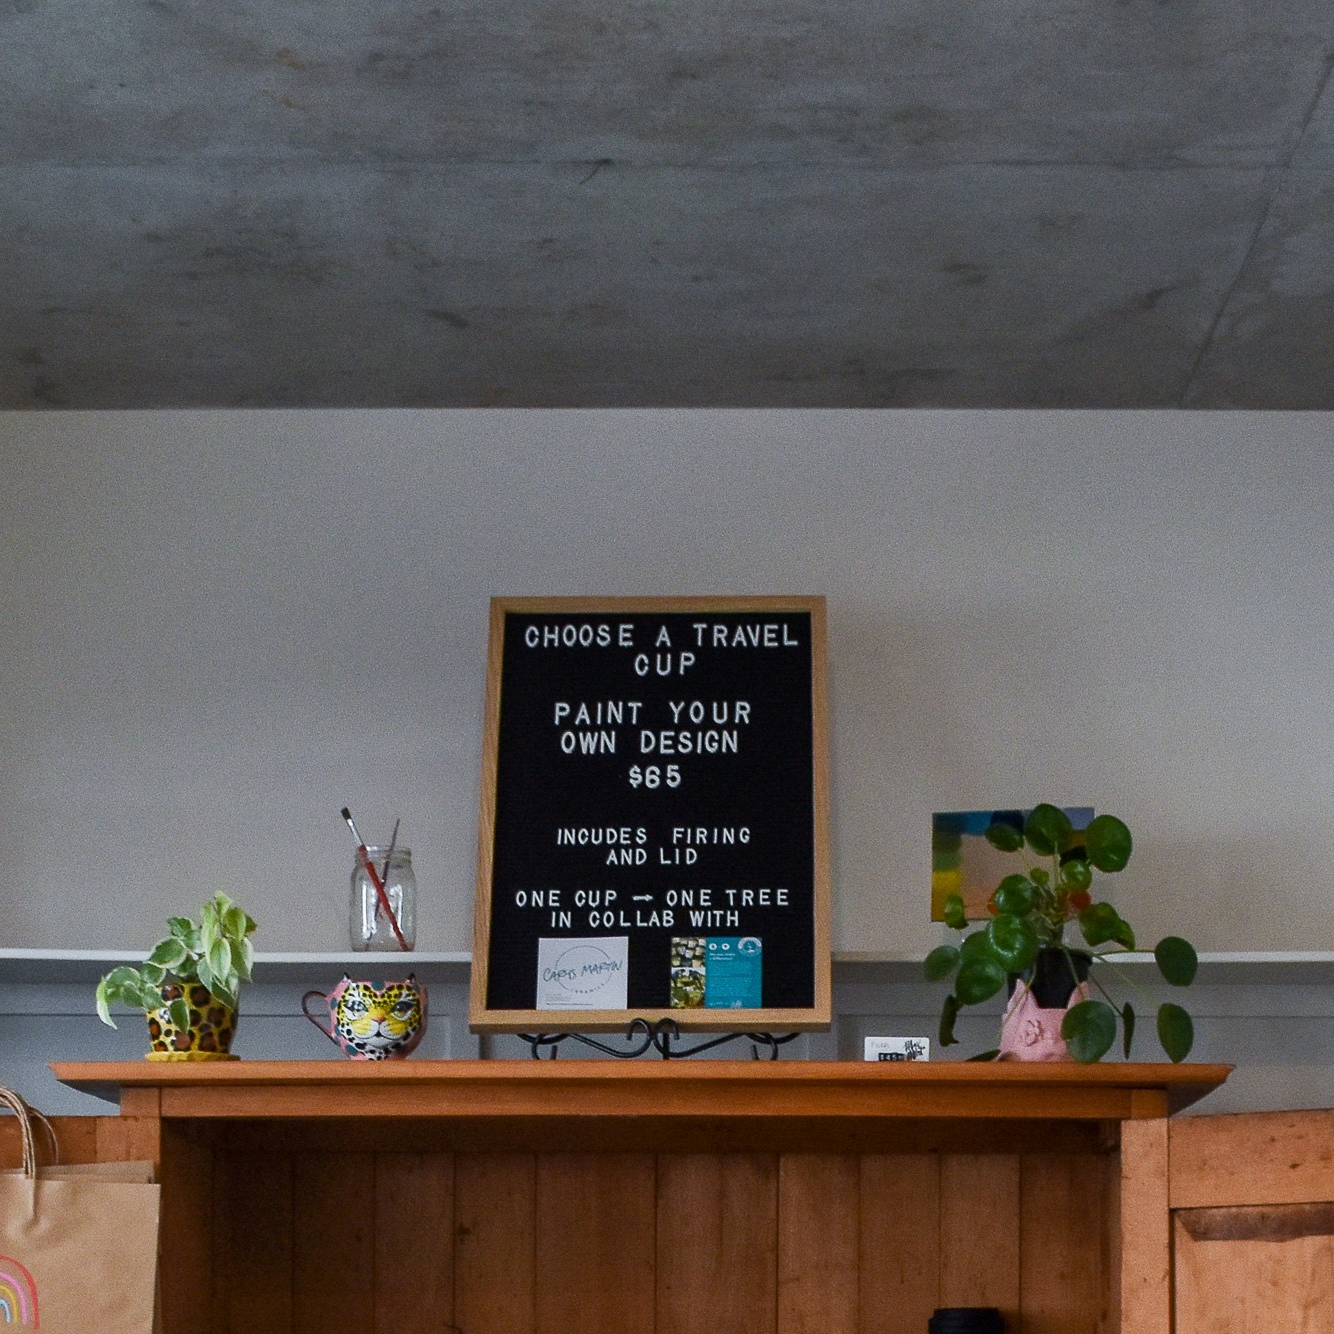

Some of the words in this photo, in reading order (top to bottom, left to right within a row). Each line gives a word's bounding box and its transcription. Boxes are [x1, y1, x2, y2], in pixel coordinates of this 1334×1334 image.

[525, 624, 634, 648] CHOOSE
[656, 625, 671, 647] A
[694, 623, 798, 647] TRAVEL
[634, 652, 696, 676] CUP
[554, 701, 643, 726] PAINT
[669, 700, 751, 725] YOUR
[560, 730, 616, 754] OWN
[640, 730, 738, 754] DESIGN
[629, 764, 681, 789] $65
[557, 827, 647, 846] INCUDES
[672, 827, 751, 845] FIRING
[606, 848, 647, 866] AND
[659, 848, 698, 865] LID
[516, 890, 561, 908] ONE
[574, 890, 617, 907] CUP
[666, 889, 712, 907] ONE
[726, 889, 789, 907] TREE
[551, 911, 572, 928] IN
[589, 910, 675, 928] COLLAB
[689, 911, 739, 928] WITH
